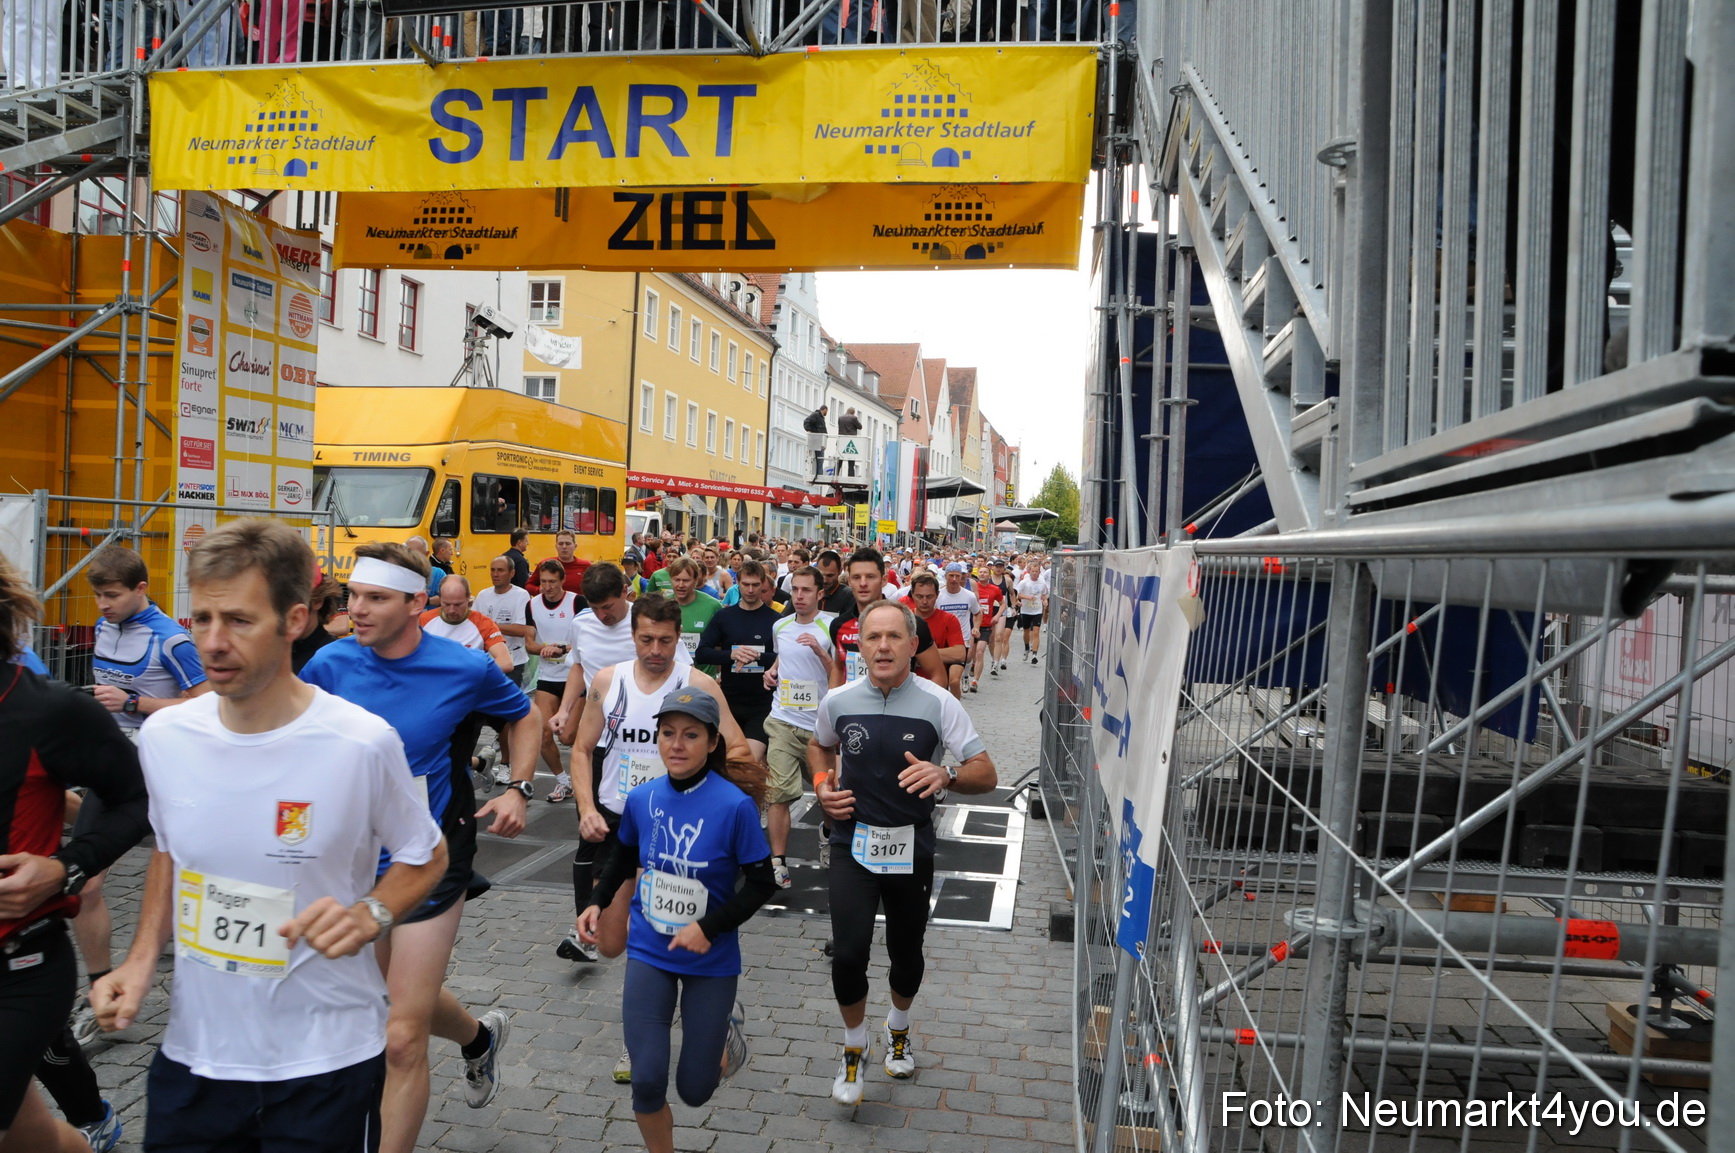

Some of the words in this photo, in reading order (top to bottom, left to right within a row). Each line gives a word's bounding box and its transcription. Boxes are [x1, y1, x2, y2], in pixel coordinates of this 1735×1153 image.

[428, 84, 757, 164] START
[814, 122, 935, 139] Neumarkter
[939, 120, 1036, 139] Stadtlauf
[187, 136, 289, 152] Neumarkter
[292, 135, 376, 152] Stadtlauf
[608, 191, 776, 250] ZIEL
[366, 226, 450, 239] Neumarkter
[452, 225, 519, 240] Stadtlauf
[872, 223, 968, 237] Neumarkter
[971, 221, 1044, 237] Stadtlauf
[193, 290, 211, 301] KANN
[288, 311, 314, 325] WITTMANN
[181, 362, 216, 380] Sinupret
[281, 363, 316, 386] OBI
[181, 378, 202, 392] forte
[191, 405, 217, 415] Egner
[279, 422, 304, 438] MCM
[194, 440, 203, 448] FÜR
[353, 451, 412, 462] TIMING
[496, 451, 529, 464] SPORTRONIC
[573, 464, 587, 475] EVENT
[587, 467, 604, 477] SERVICE
[183, 482, 216, 492] INTERSPORT
[277, 484, 300, 493] GERHART
[641, 475, 665, 485] Service
[677, 480, 693, 488] Miet-
[700, 482, 733, 493] Serviceline:
[734, 486, 750, 494] 09181
[750, 488, 765, 496] 6352
[178, 490, 215, 501] HACKNER
[240, 490, 254, 498] MAX
[254, 489, 270, 499] BÖGL
[792, 692, 812, 702] 445
[630, 760, 650, 772] Peter
[871, 830, 891, 841] Erich
[870, 843, 907, 857] 3107
[655, 877, 695, 897] Christine
[207, 884, 251, 909] Roger
[655, 895, 697, 916] 3409
[214, 915, 267, 948] 871
